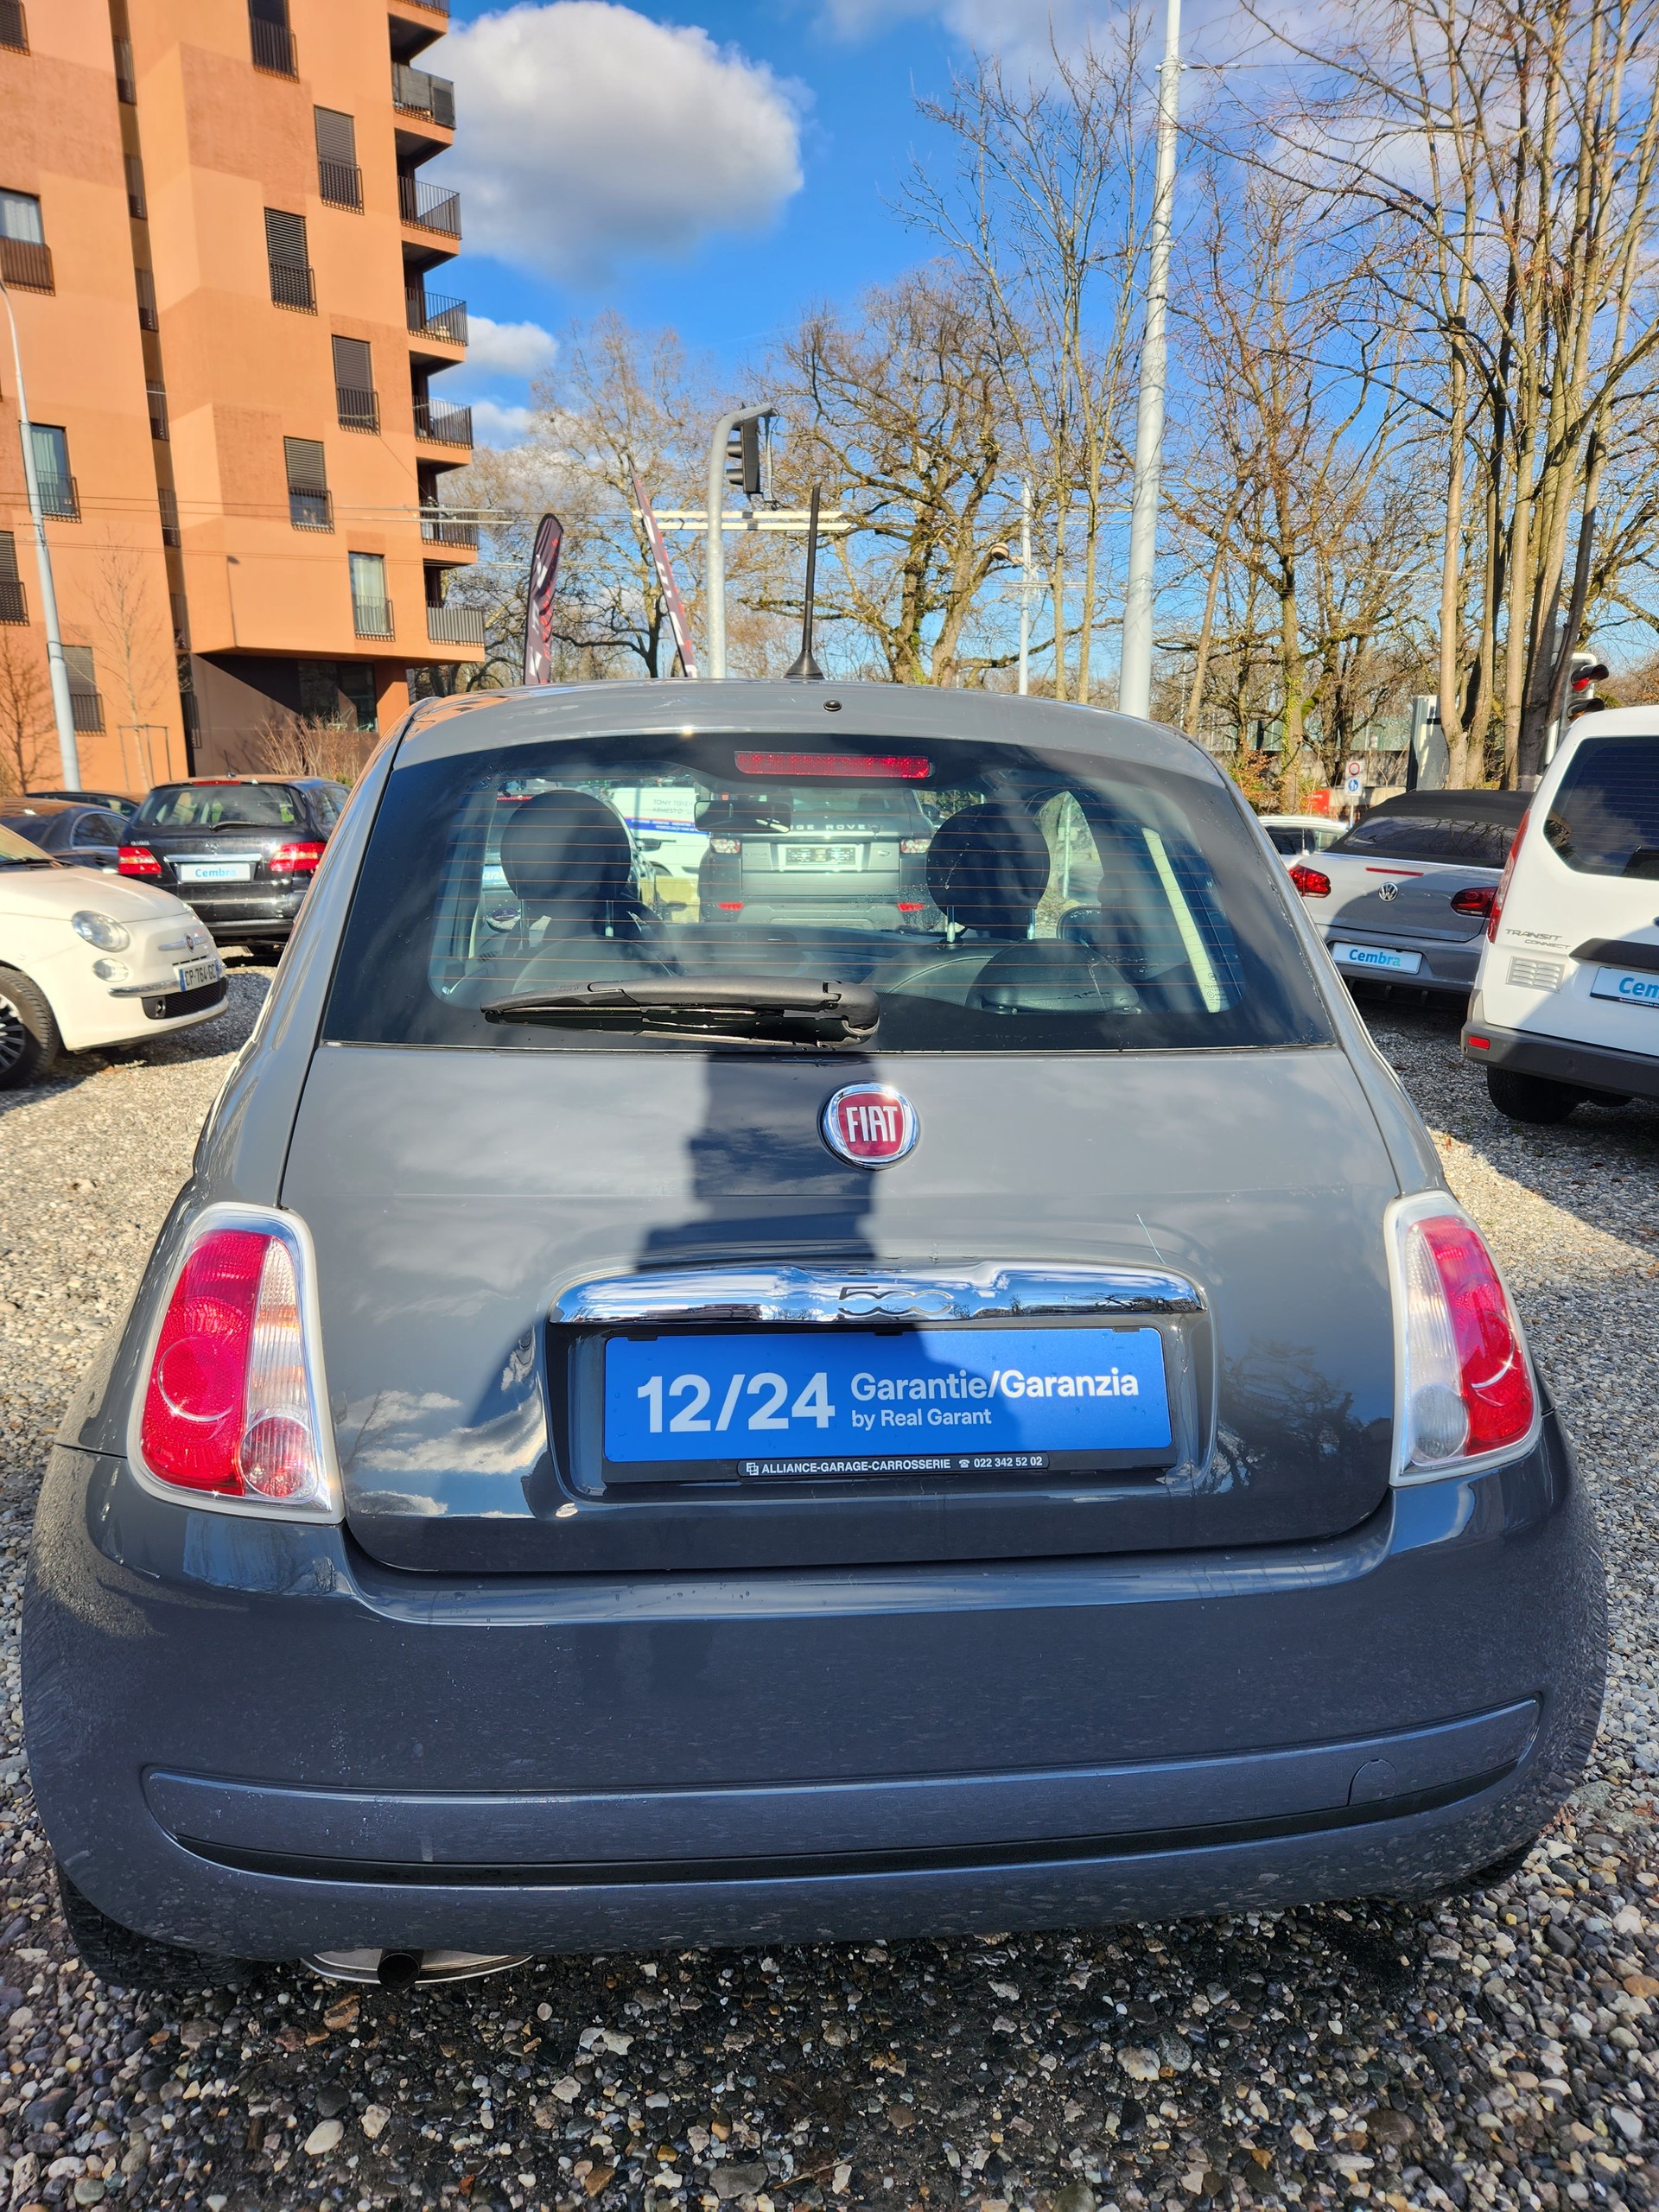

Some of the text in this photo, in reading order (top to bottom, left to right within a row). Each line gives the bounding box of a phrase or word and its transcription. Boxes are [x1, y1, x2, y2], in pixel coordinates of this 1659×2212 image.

[195, 868, 236, 878] Cembra
[1505, 928, 1562, 941] TRANSIT
[1524, 939, 1571, 950] CONNECT
[1349, 949, 1401, 967] Cembra
[845, 1105, 899, 1143] FIAT
[838, 1286, 954, 1316] 500
[850, 1366, 1139, 1402] Garantie/Garanzia
[637, 1371, 836, 1433] 12/24
[851, 1407, 992, 1431] by Real Garant
[761, 1456, 1043, 1474] ALLIANCE-GARAGE-CARROSSERIE 022 342 52 02
